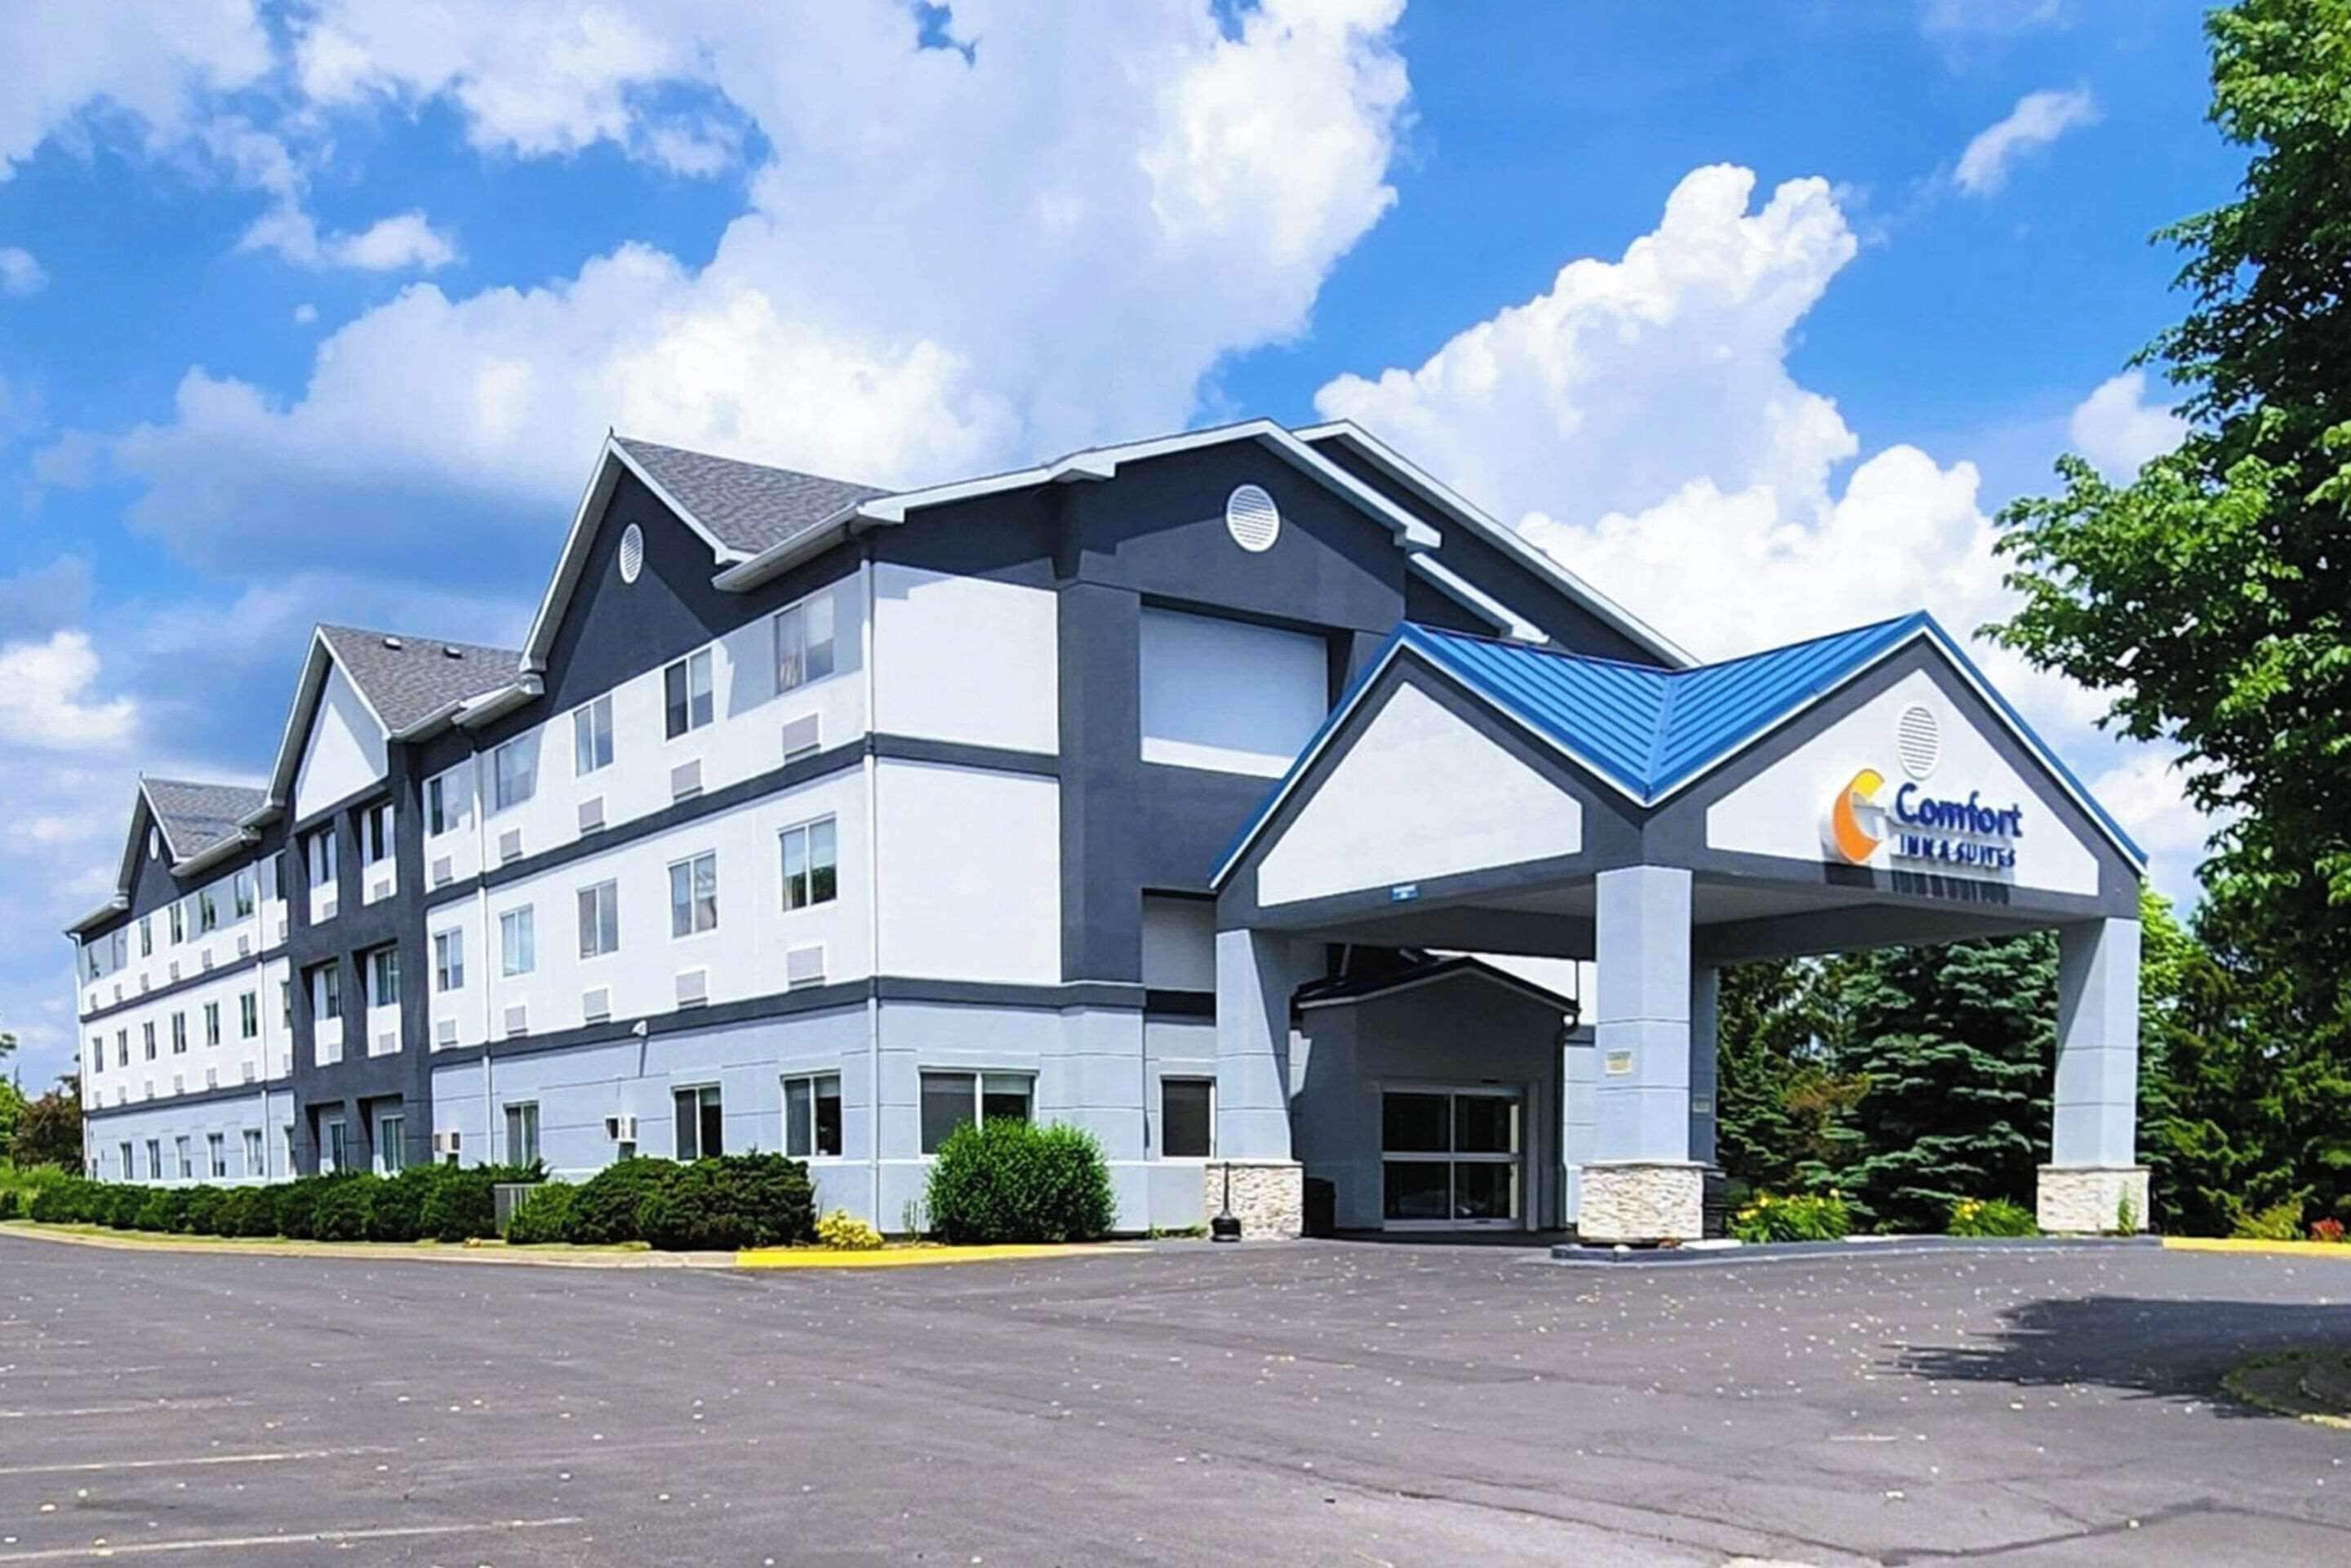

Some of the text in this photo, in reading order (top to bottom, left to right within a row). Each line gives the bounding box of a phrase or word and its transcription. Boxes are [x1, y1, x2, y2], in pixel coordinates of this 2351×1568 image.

[1896, 782, 2023, 837] Comfort
[1900, 833, 1933, 858] INN
[1956, 842, 2016, 868] SUITES
